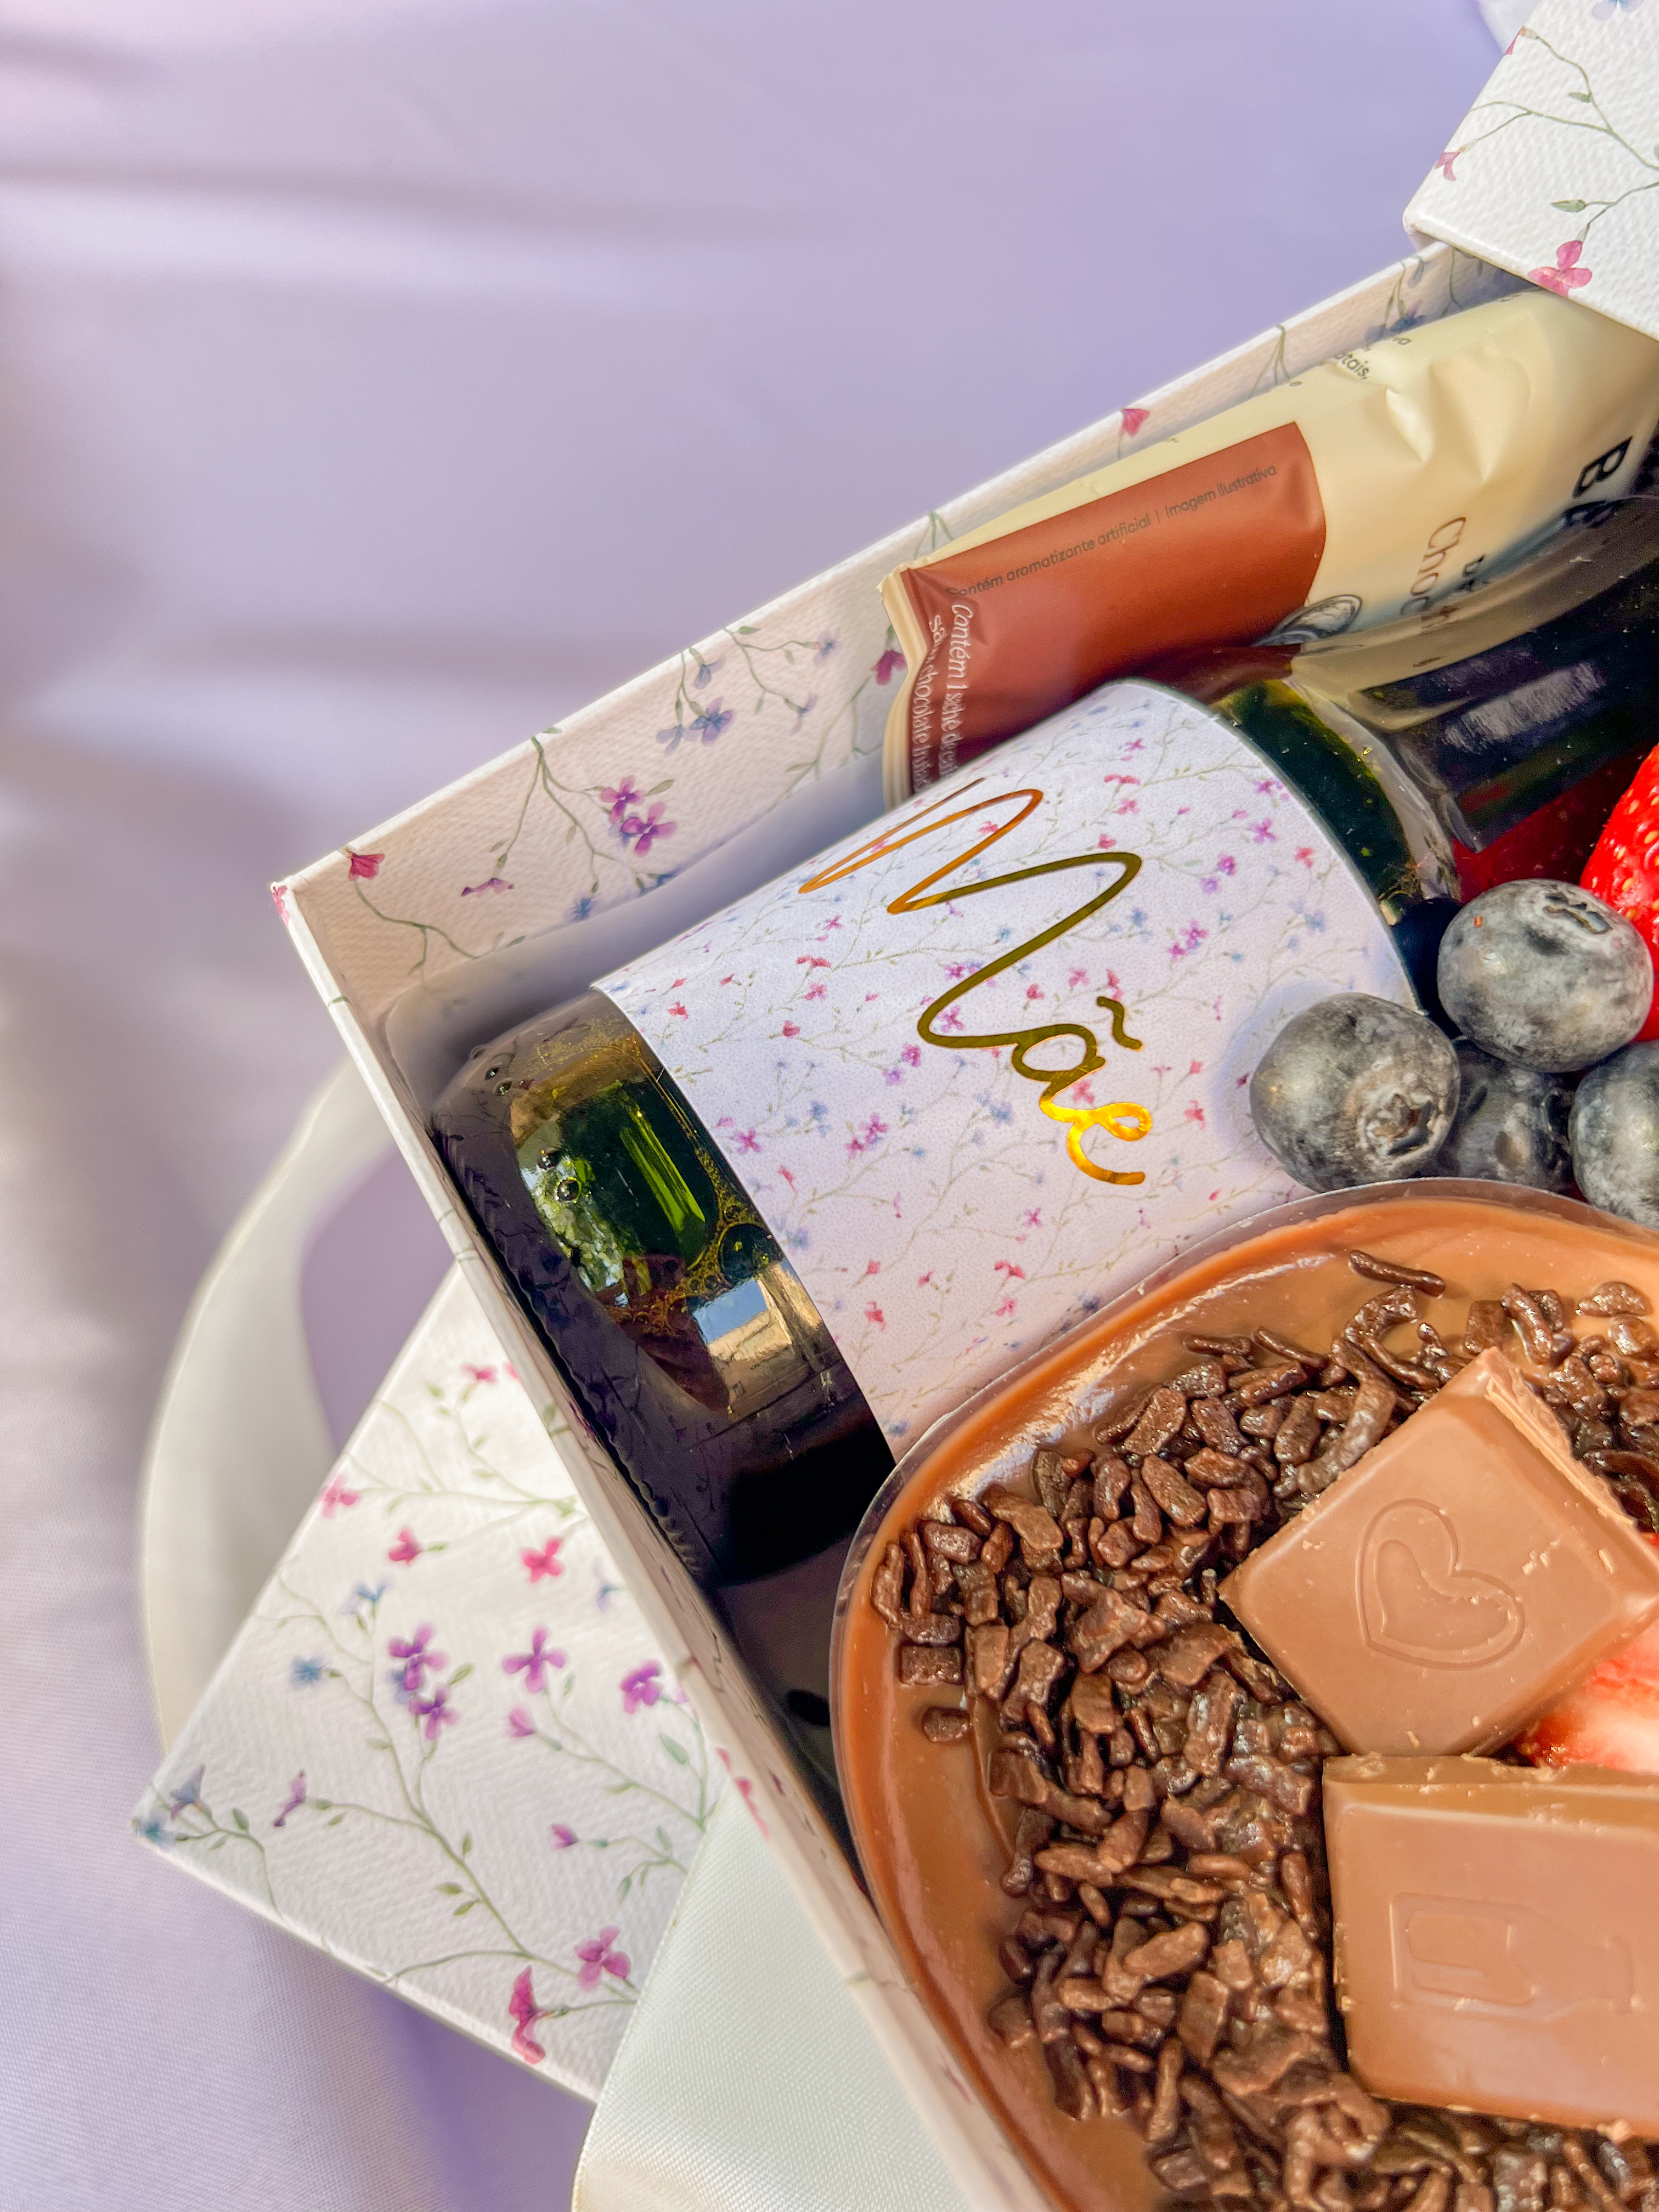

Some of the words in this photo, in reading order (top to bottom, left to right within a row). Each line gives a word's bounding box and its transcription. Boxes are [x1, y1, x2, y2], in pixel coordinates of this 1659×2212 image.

[946, 575, 1003, 596] Contém
[1006, 539, 1095, 582] aromatizante
[1097, 512, 1150, 545] artificial
[1164, 490, 1216, 518] Imagem
[1216, 465, 1277, 497] ilustrativa
[945, 604, 974, 679] Contém
[798, 777, 1153, 1186] Mãe
